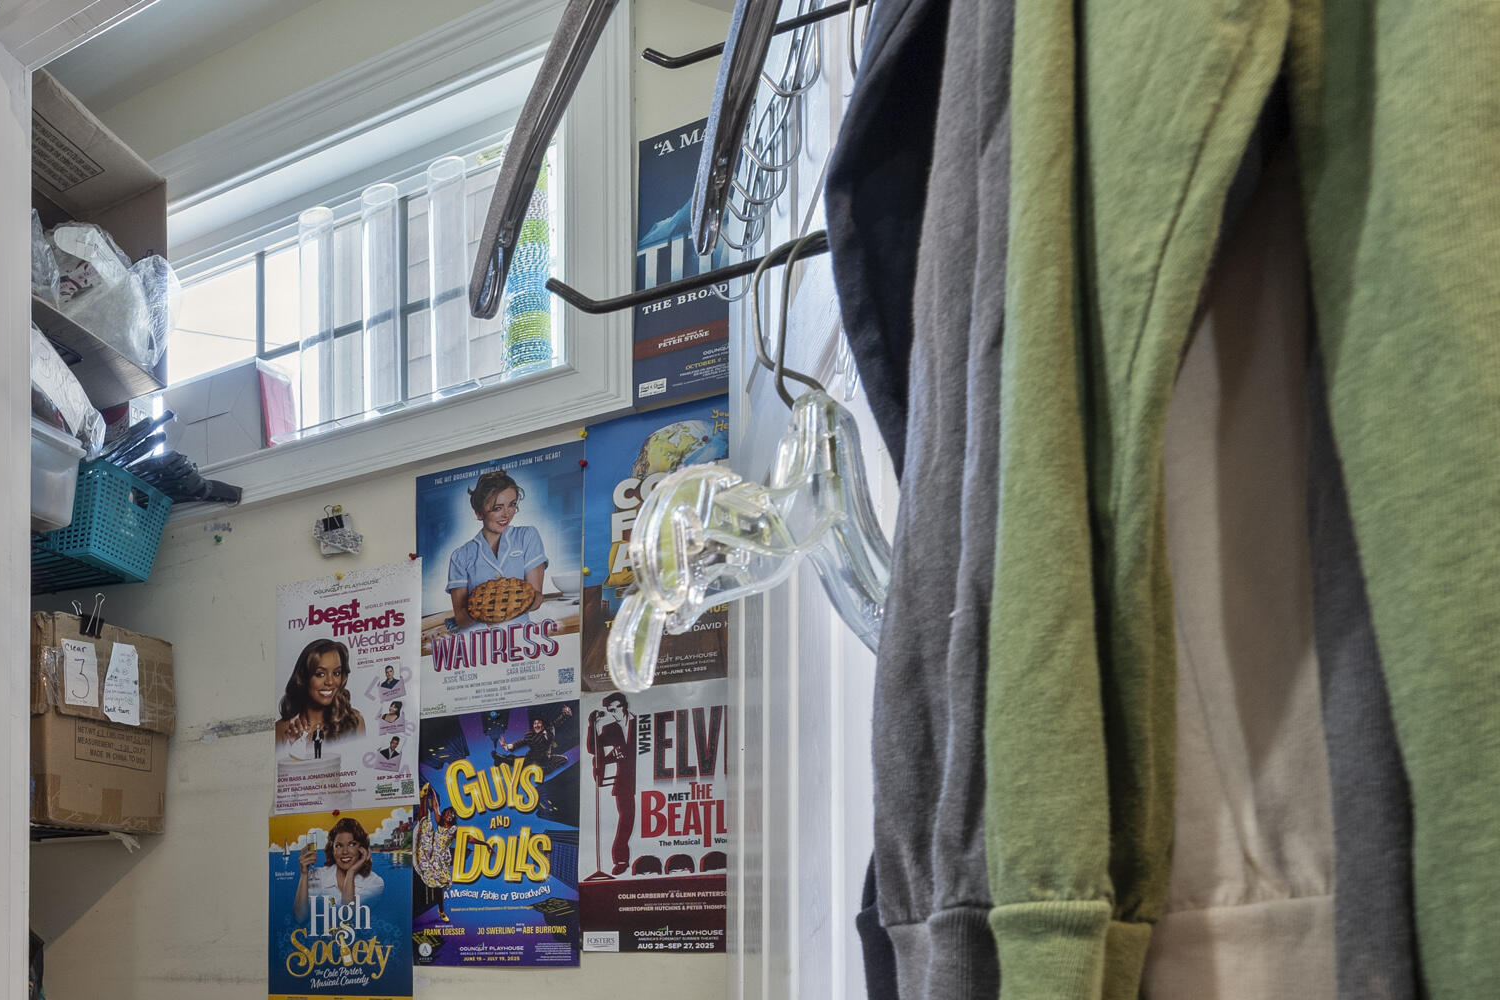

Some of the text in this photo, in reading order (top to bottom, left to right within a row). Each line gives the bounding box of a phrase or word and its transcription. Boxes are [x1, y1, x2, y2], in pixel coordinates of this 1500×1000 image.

[642, 299, 672, 315] THE
[658, 330, 710, 349] PETER STONE
[685, 359, 716, 371] OCTOBER
[434, 478, 443, 486] THE
[453, 471, 479, 483] BROADWAY
[502, 462, 518, 472] BAKED
[519, 458, 533, 467] FROM
[534, 455, 543, 463] THE
[545, 451, 561, 460] HEART
[344, 579, 379, 590] PLAYHOUSE
[364, 598, 411, 610] WORLD PREMIERE
[288, 598, 360, 631] my best
[693, 621, 722, 632] DAVID
[348, 630, 405, 648] Wedding
[431, 618, 559, 672] WAITRESS
[64, 643, 87, 653] Clear
[370, 643, 395, 653] musical
[675, 651, 718, 661] PLAYHOUSE
[71, 658, 90, 699] 3
[638, 713, 652, 755] WHEN
[653, 704, 728, 781] ELV
[445, 758, 544, 819] GUYS
[667, 781, 713, 802] MET THE
[489, 815, 511, 830] AND
[673, 838, 701, 847] Musical
[452, 826, 552, 884] DOLLS
[443, 884, 551, 901] A Musical Fable of Broadway
[308, 895, 372, 947] High
[423, 927, 442, 936] FRANK
[442, 926, 466, 936] LOESSER
[476, 926, 485, 936] JO
[485, 926, 516, 935] SWERLING
[522, 925, 534, 934] ABE
[535, 925, 567, 935] BURROWS
[634, 926, 674, 937] OGUNQUIT
[459, 943, 489, 952] OGUNQUIT
[683, 942, 694, 950] 27,
[323, 967, 338, 978] Cole
[338, 966, 364, 977] Porter
[310, 974, 371, 989] Musical Comedy
